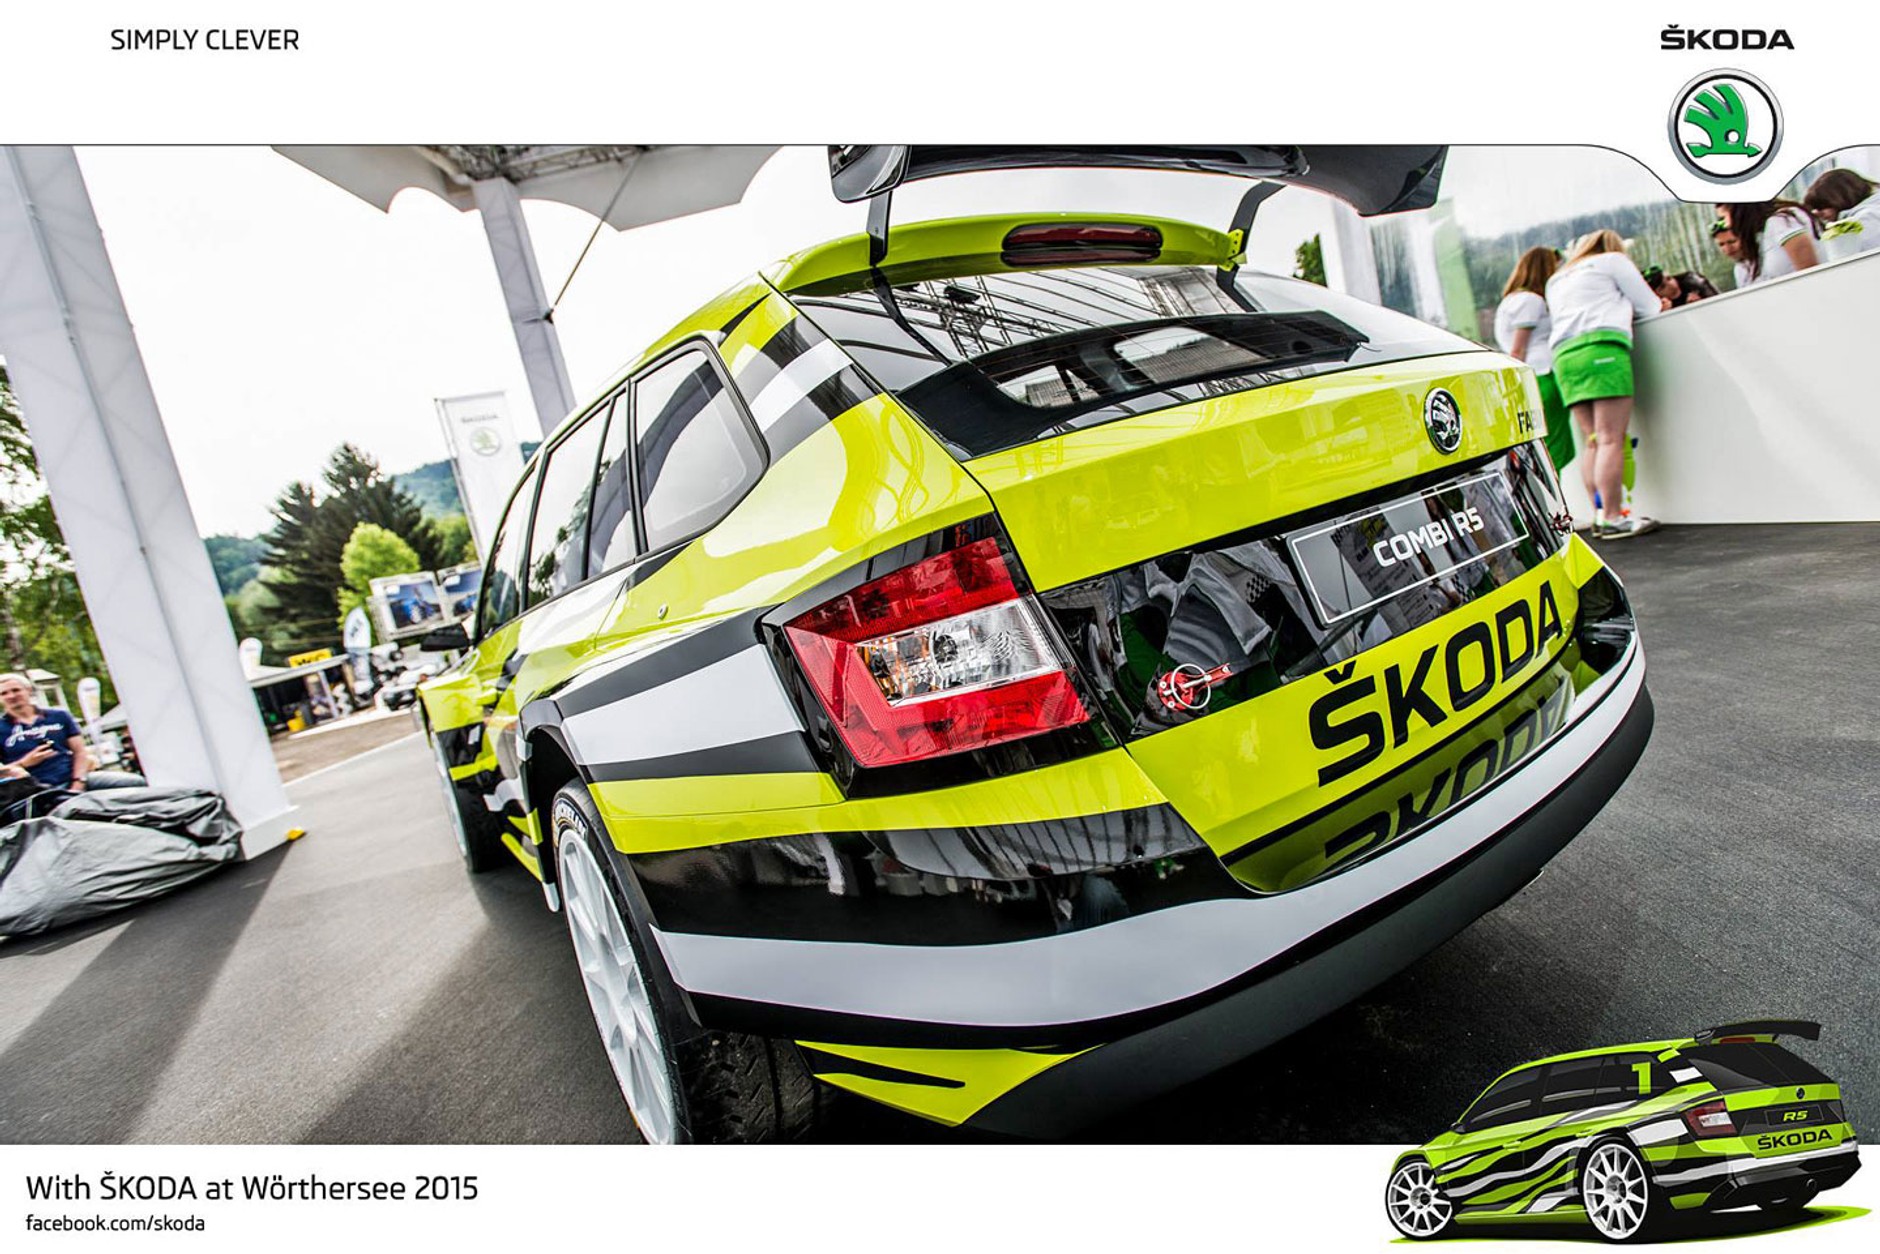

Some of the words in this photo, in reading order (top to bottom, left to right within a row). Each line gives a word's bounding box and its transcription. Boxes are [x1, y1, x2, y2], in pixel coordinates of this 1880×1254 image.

[1373, 518, 1454, 568] COMBI
[1451, 507, 1484, 537] R5
[1309, 580, 1563, 788] ŠKODA
